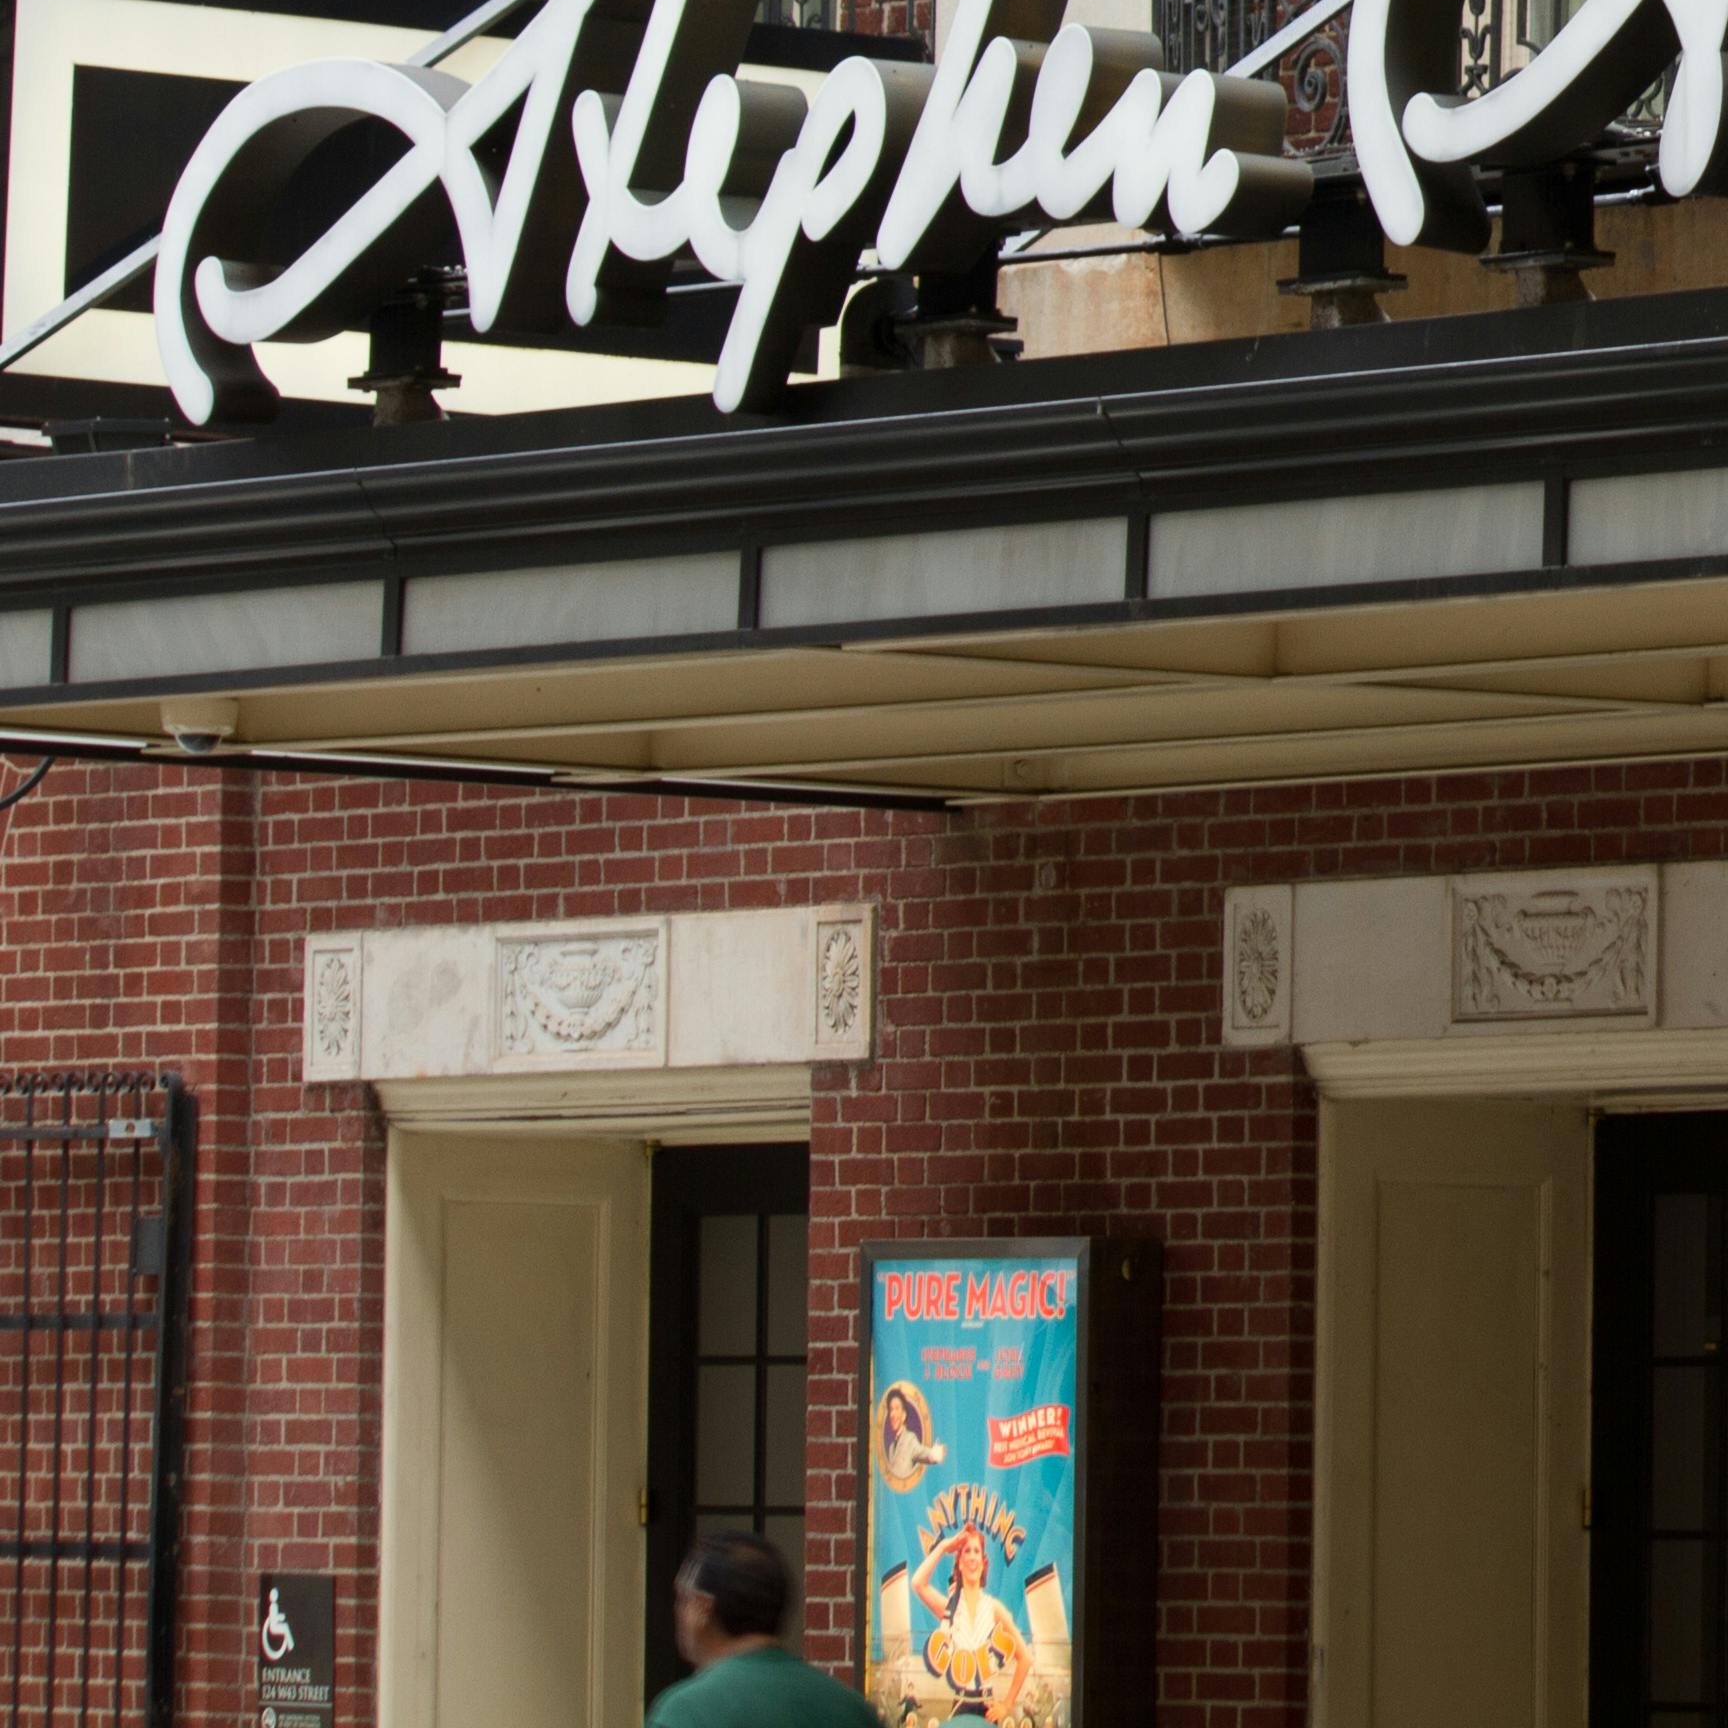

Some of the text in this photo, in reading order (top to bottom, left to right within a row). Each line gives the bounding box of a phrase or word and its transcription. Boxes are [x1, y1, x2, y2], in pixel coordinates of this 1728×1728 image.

[998, 1407, 1063, 1439] WINNER!
[917, 1482, 1027, 1560] ANYTHING
[926, 1622, 1018, 1688] GOES
[262, 1666, 312, 1683] ENTRANCE
[298, 1684, 330, 1702] STREET
